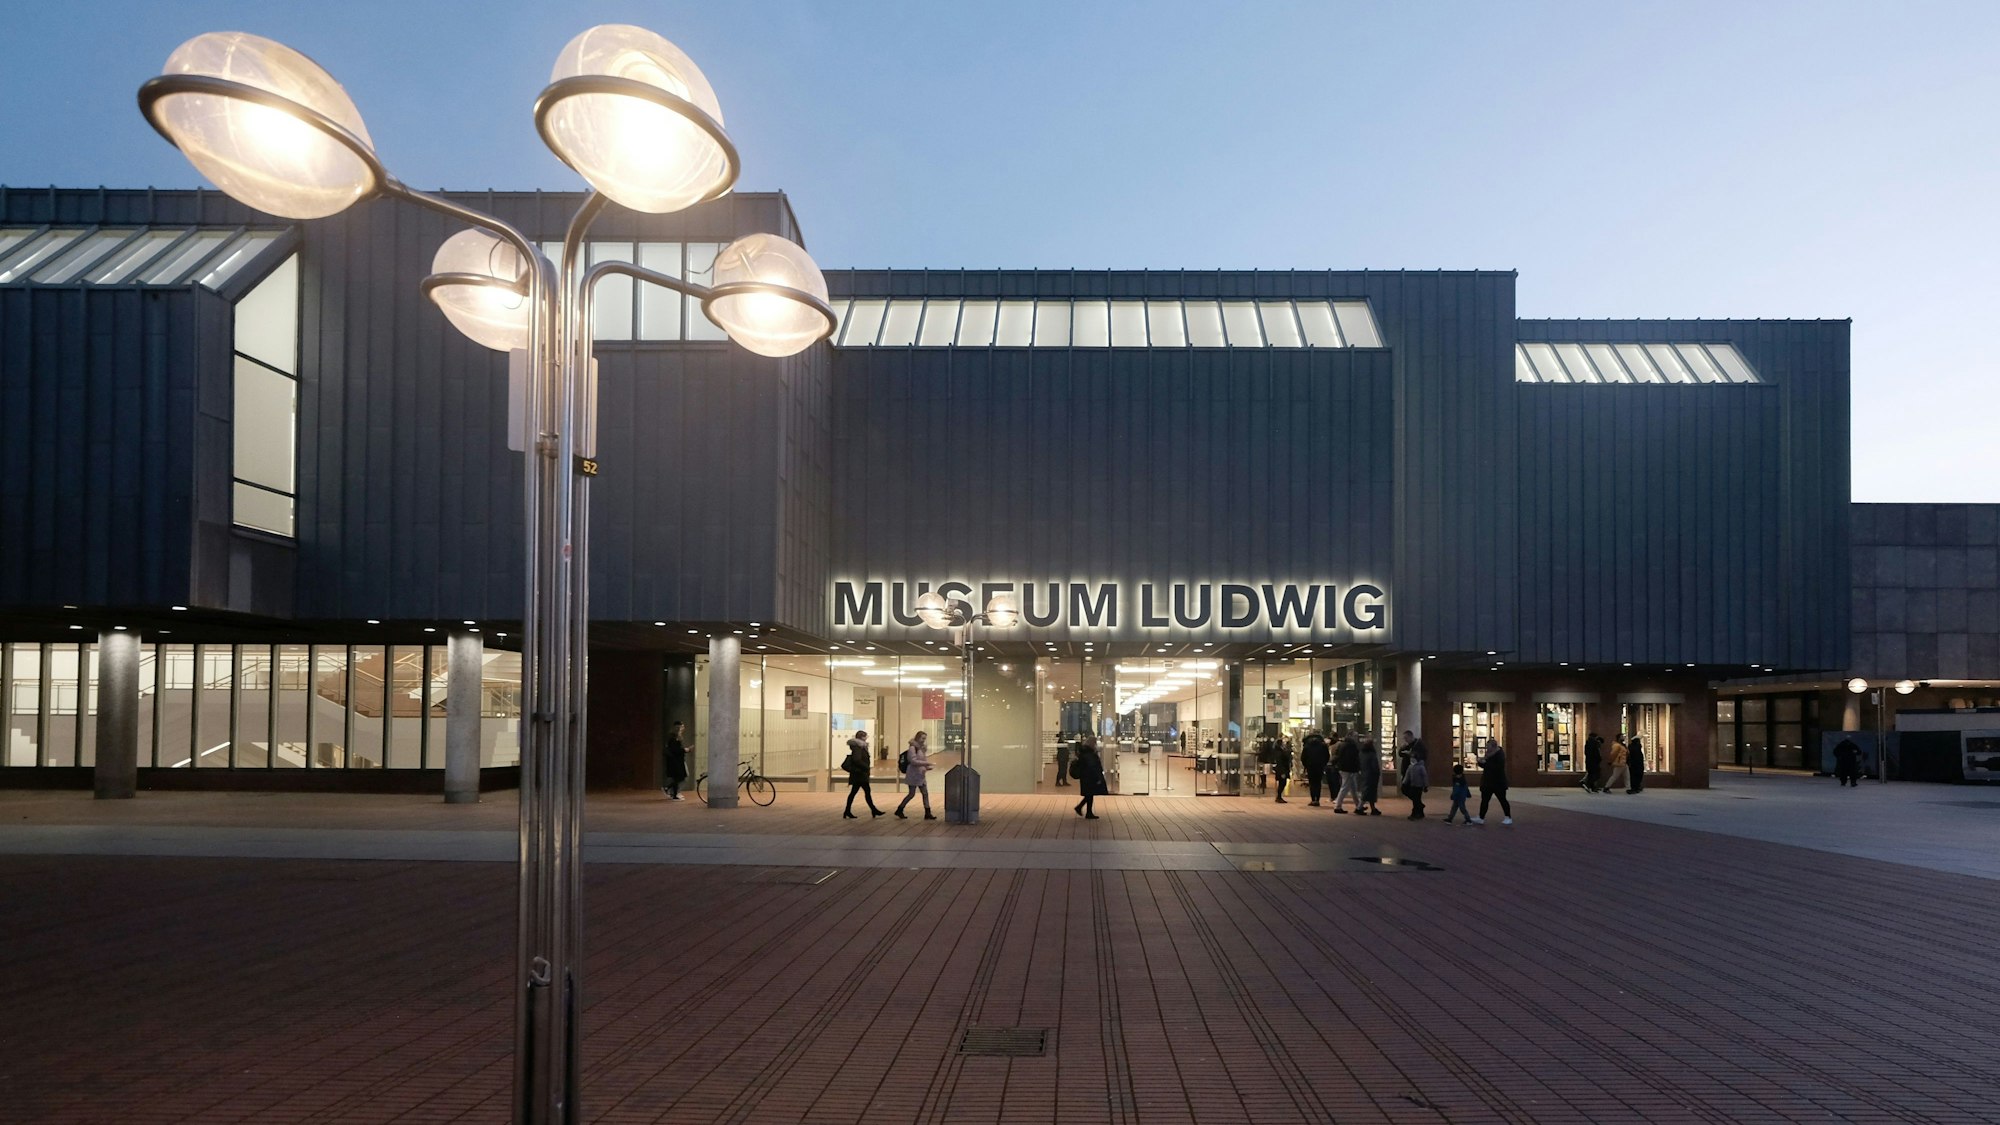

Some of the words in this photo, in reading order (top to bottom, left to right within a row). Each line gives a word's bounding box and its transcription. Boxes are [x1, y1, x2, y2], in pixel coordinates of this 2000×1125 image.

[583, 461, 598, 475] 52
[834, 582, 1117, 628] MUSEUM
[1142, 584, 1385, 630] LUDWIG
